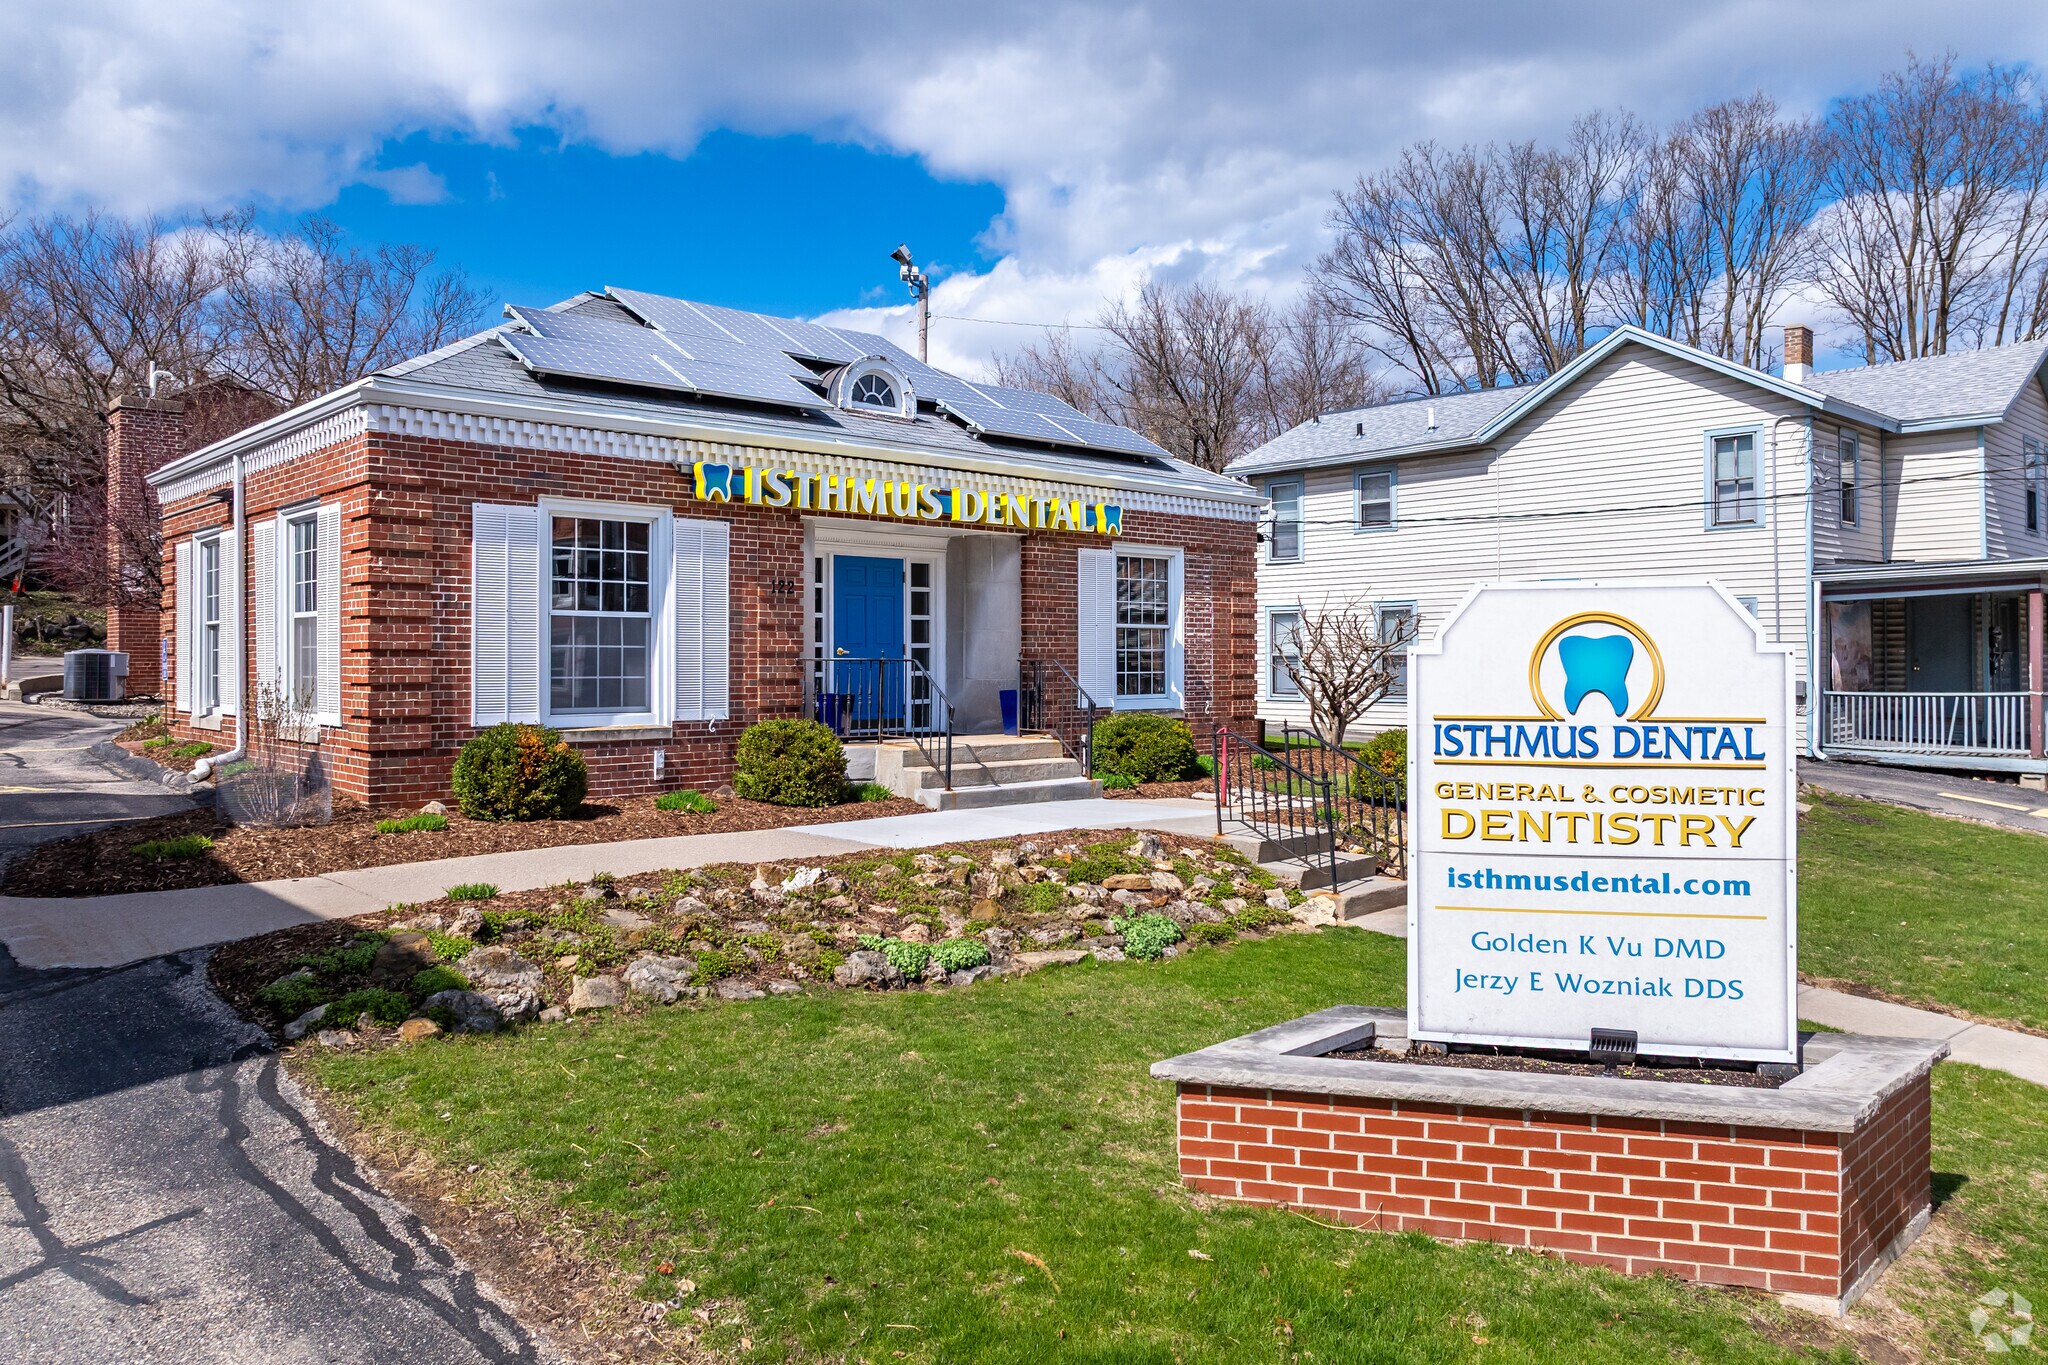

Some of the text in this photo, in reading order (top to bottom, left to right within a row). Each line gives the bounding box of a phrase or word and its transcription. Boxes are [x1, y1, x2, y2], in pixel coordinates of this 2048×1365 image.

[744, 465, 1095, 532] ISTHMUS DENTAL
[771, 579, 795, 594] 122
[1433, 723, 1766, 760] ISTHMUS DENTAL
[1434, 781, 1765, 806] GENERAL & COSMETIC
[1440, 807, 1757, 849] DENTISTRY
[1447, 867, 1751, 897] isthmusdental.com
[1471, 931, 1727, 960] Golden K Vu DMD
[1454, 968, 1744, 1000] Jerzy E Wozniak DDS
